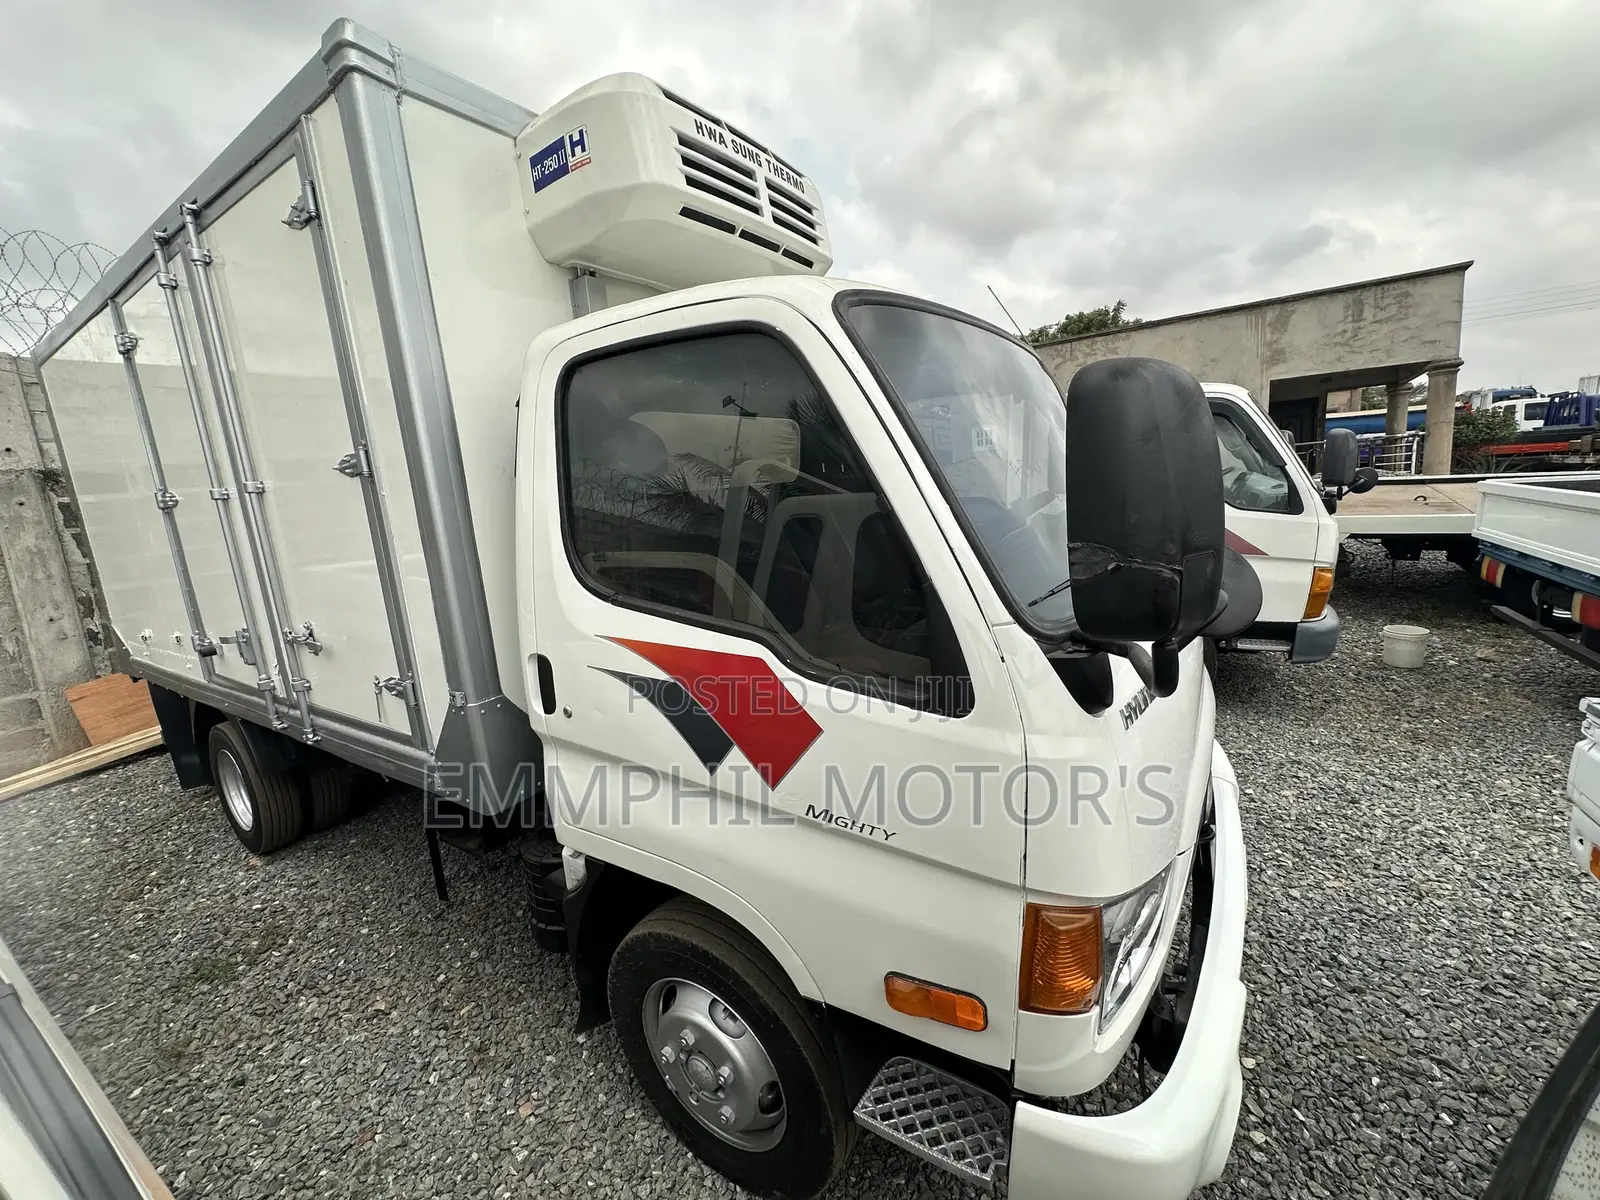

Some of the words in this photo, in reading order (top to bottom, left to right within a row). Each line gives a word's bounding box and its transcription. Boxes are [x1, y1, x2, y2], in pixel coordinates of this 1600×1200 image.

[568, 129, 587, 158] H
[694, 118, 728, 149] HWA
[731, 139, 763, 168] SUNG
[765, 158, 805, 194] THERMO
[532, 153, 559, 182] HT-250
